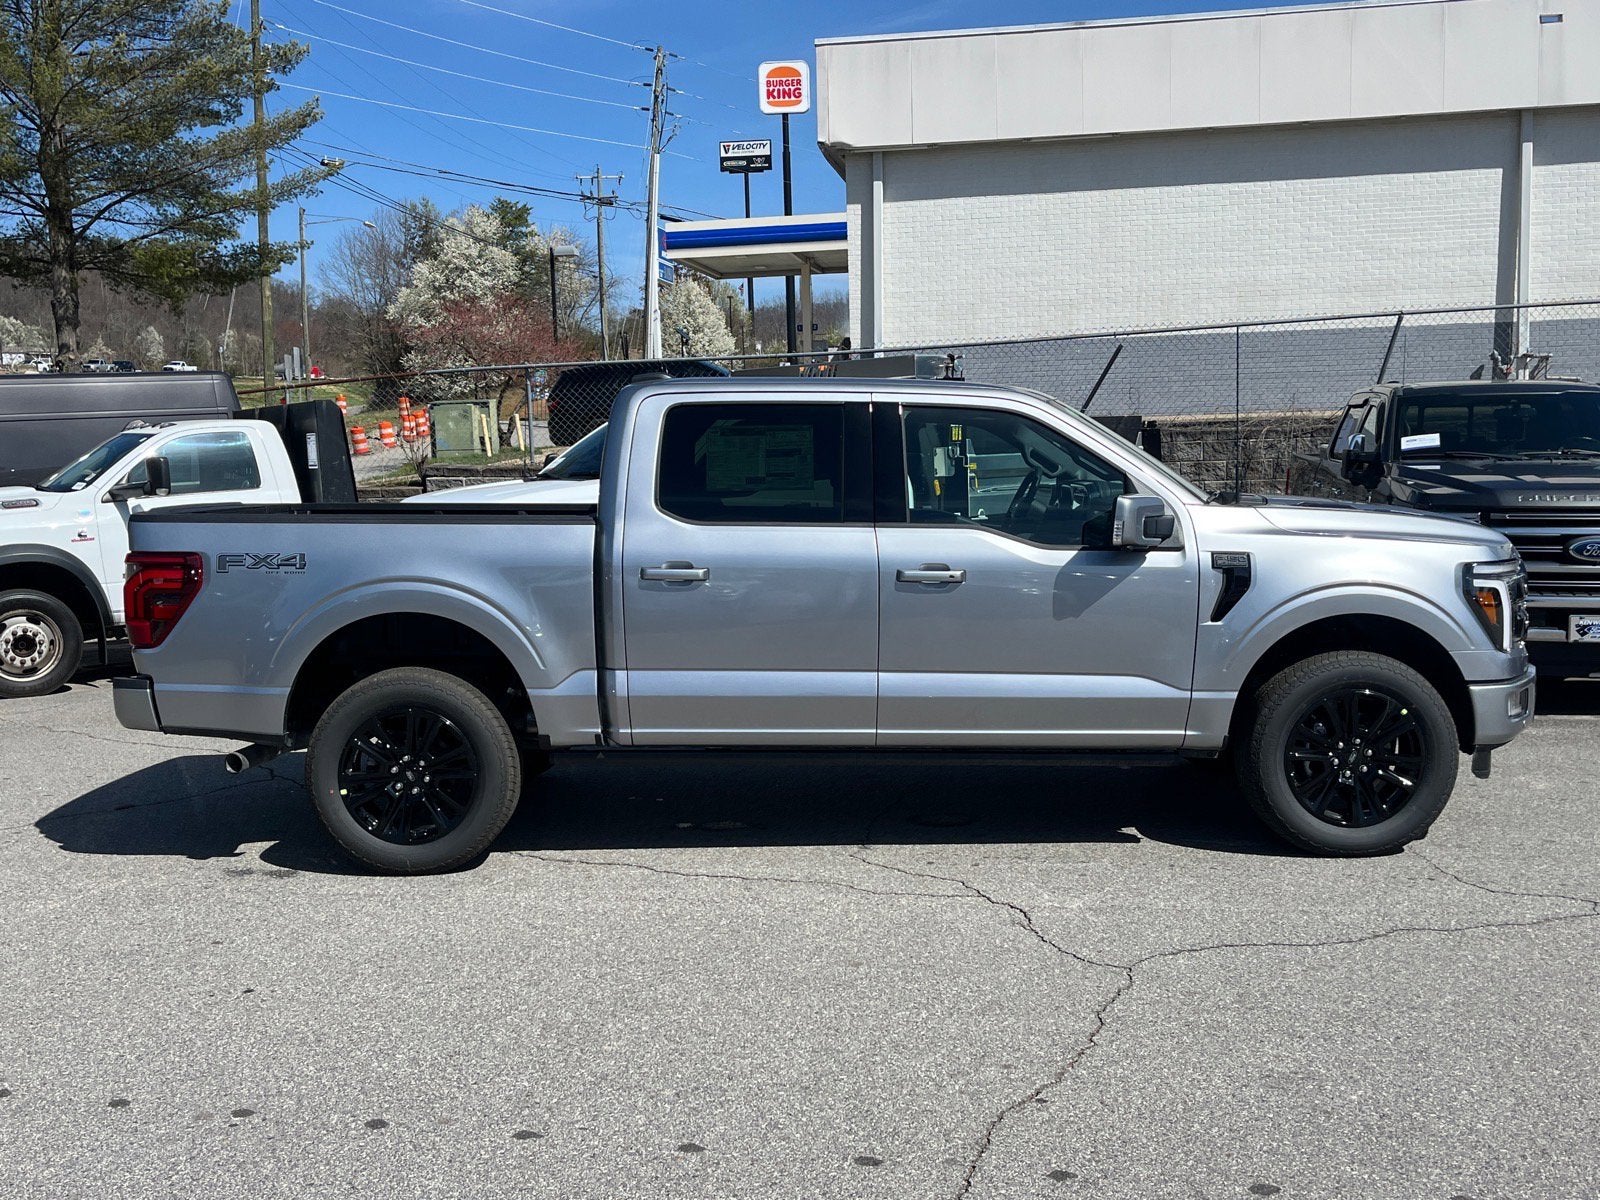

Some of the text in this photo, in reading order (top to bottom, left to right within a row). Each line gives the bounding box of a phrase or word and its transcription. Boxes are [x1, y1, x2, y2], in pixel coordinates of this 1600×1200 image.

[766, 79, 802, 88] BURGER
[766, 87, 802, 100] KING
[731, 142, 768, 151] VELOCITY
[216, 553, 306, 574] FX4
